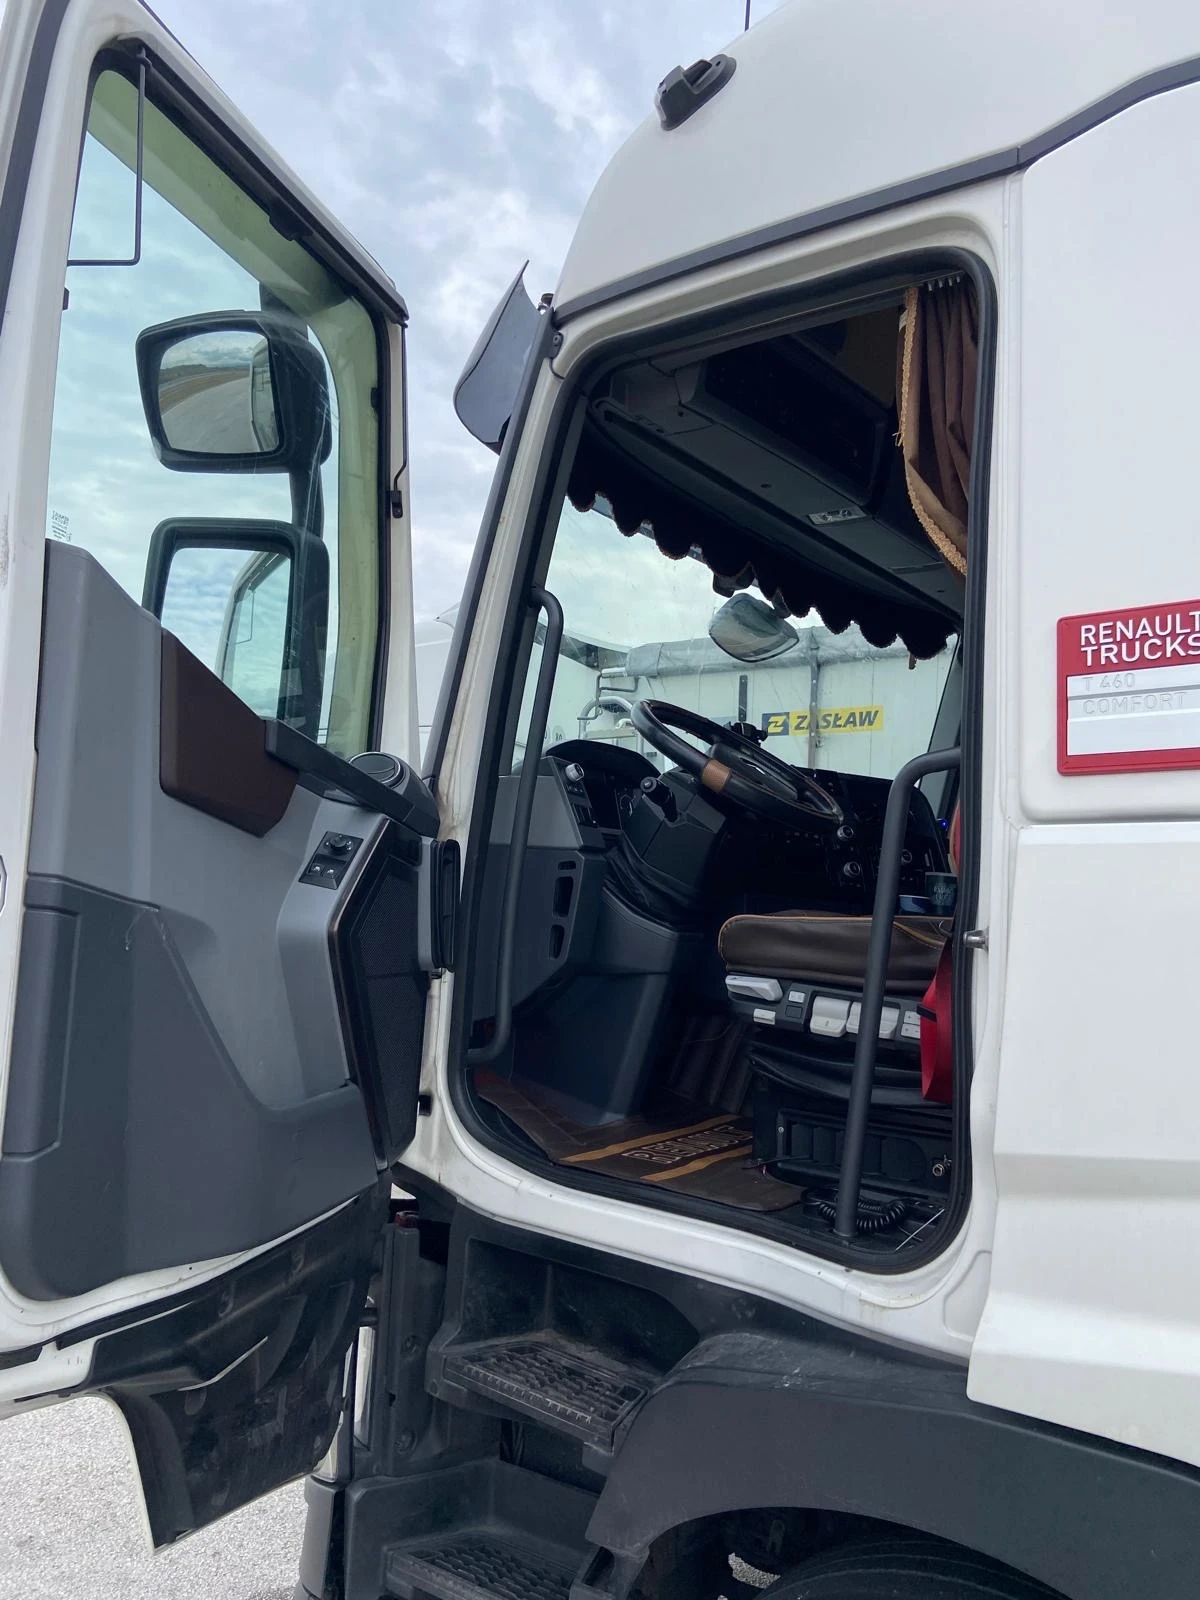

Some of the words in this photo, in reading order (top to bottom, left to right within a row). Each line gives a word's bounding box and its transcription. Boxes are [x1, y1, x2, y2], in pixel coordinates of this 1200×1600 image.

[1080, 611, 1200, 646] RENAULT
[1080, 633, 1200, 667] TRUCKS
[1082, 677, 1093, 691] T
[1100, 673, 1135, 688] 460
[1083, 692, 1186, 714] COMFORT
